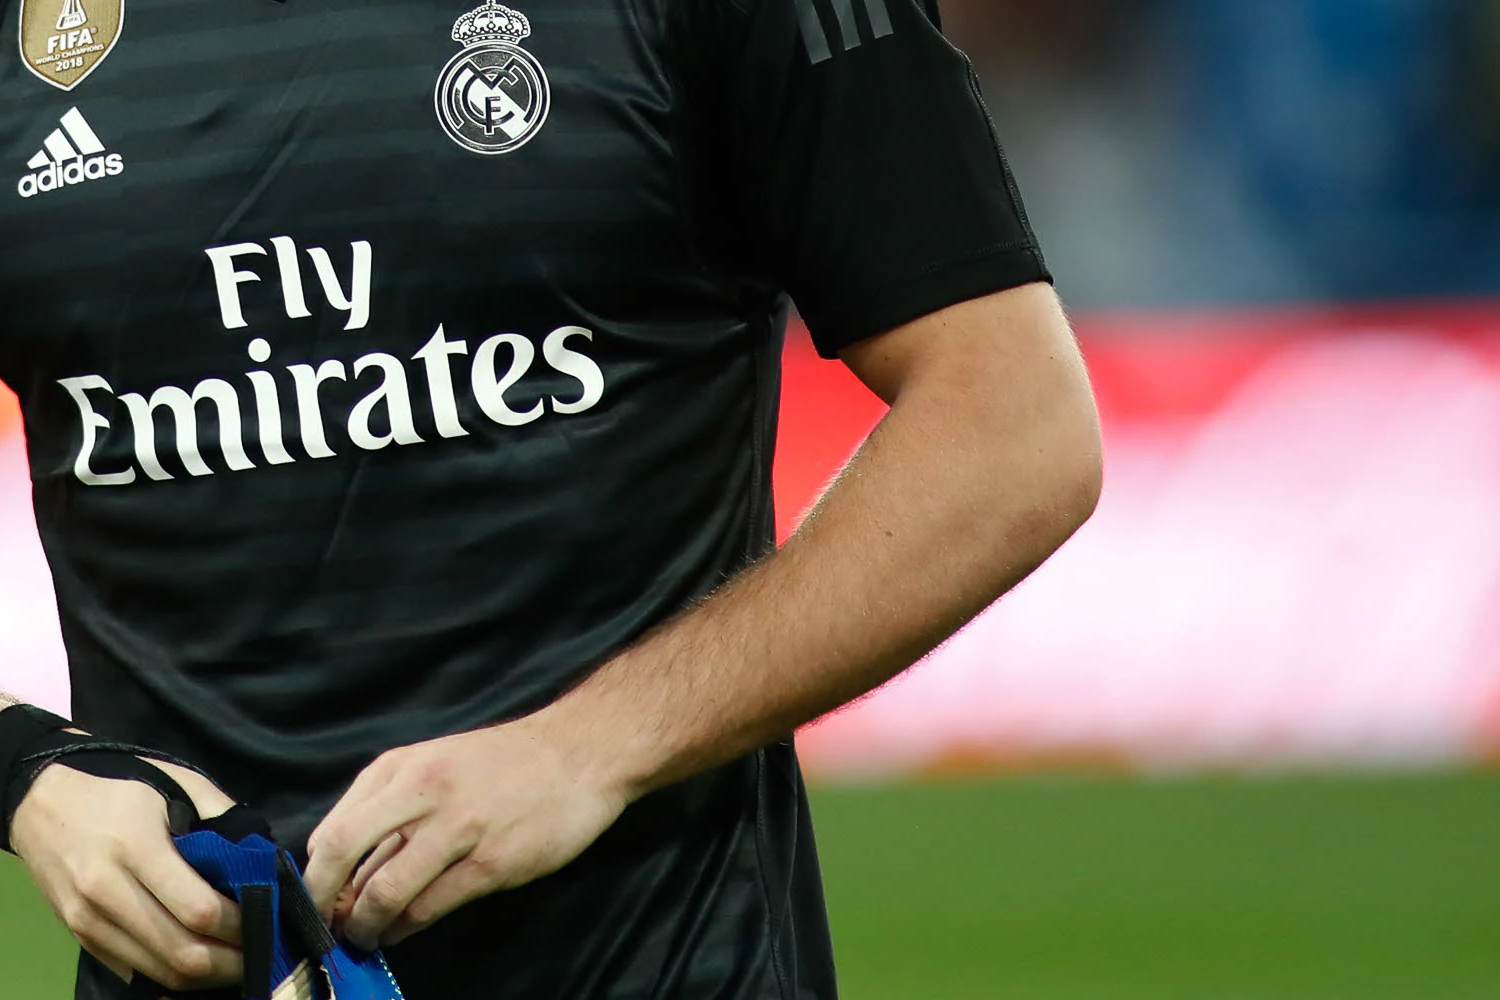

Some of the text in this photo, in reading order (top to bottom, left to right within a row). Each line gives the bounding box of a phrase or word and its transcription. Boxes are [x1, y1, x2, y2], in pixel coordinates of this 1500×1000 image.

[35, 43, 104, 65] WORLD CHAMPIONS
[47, 28, 93, 54] FIFA
[55, 56, 83, 72] 2018
[18, 153, 124, 198] adidas
[204, 235, 373, 331] Fly
[56, 322, 605, 486] Emirates
